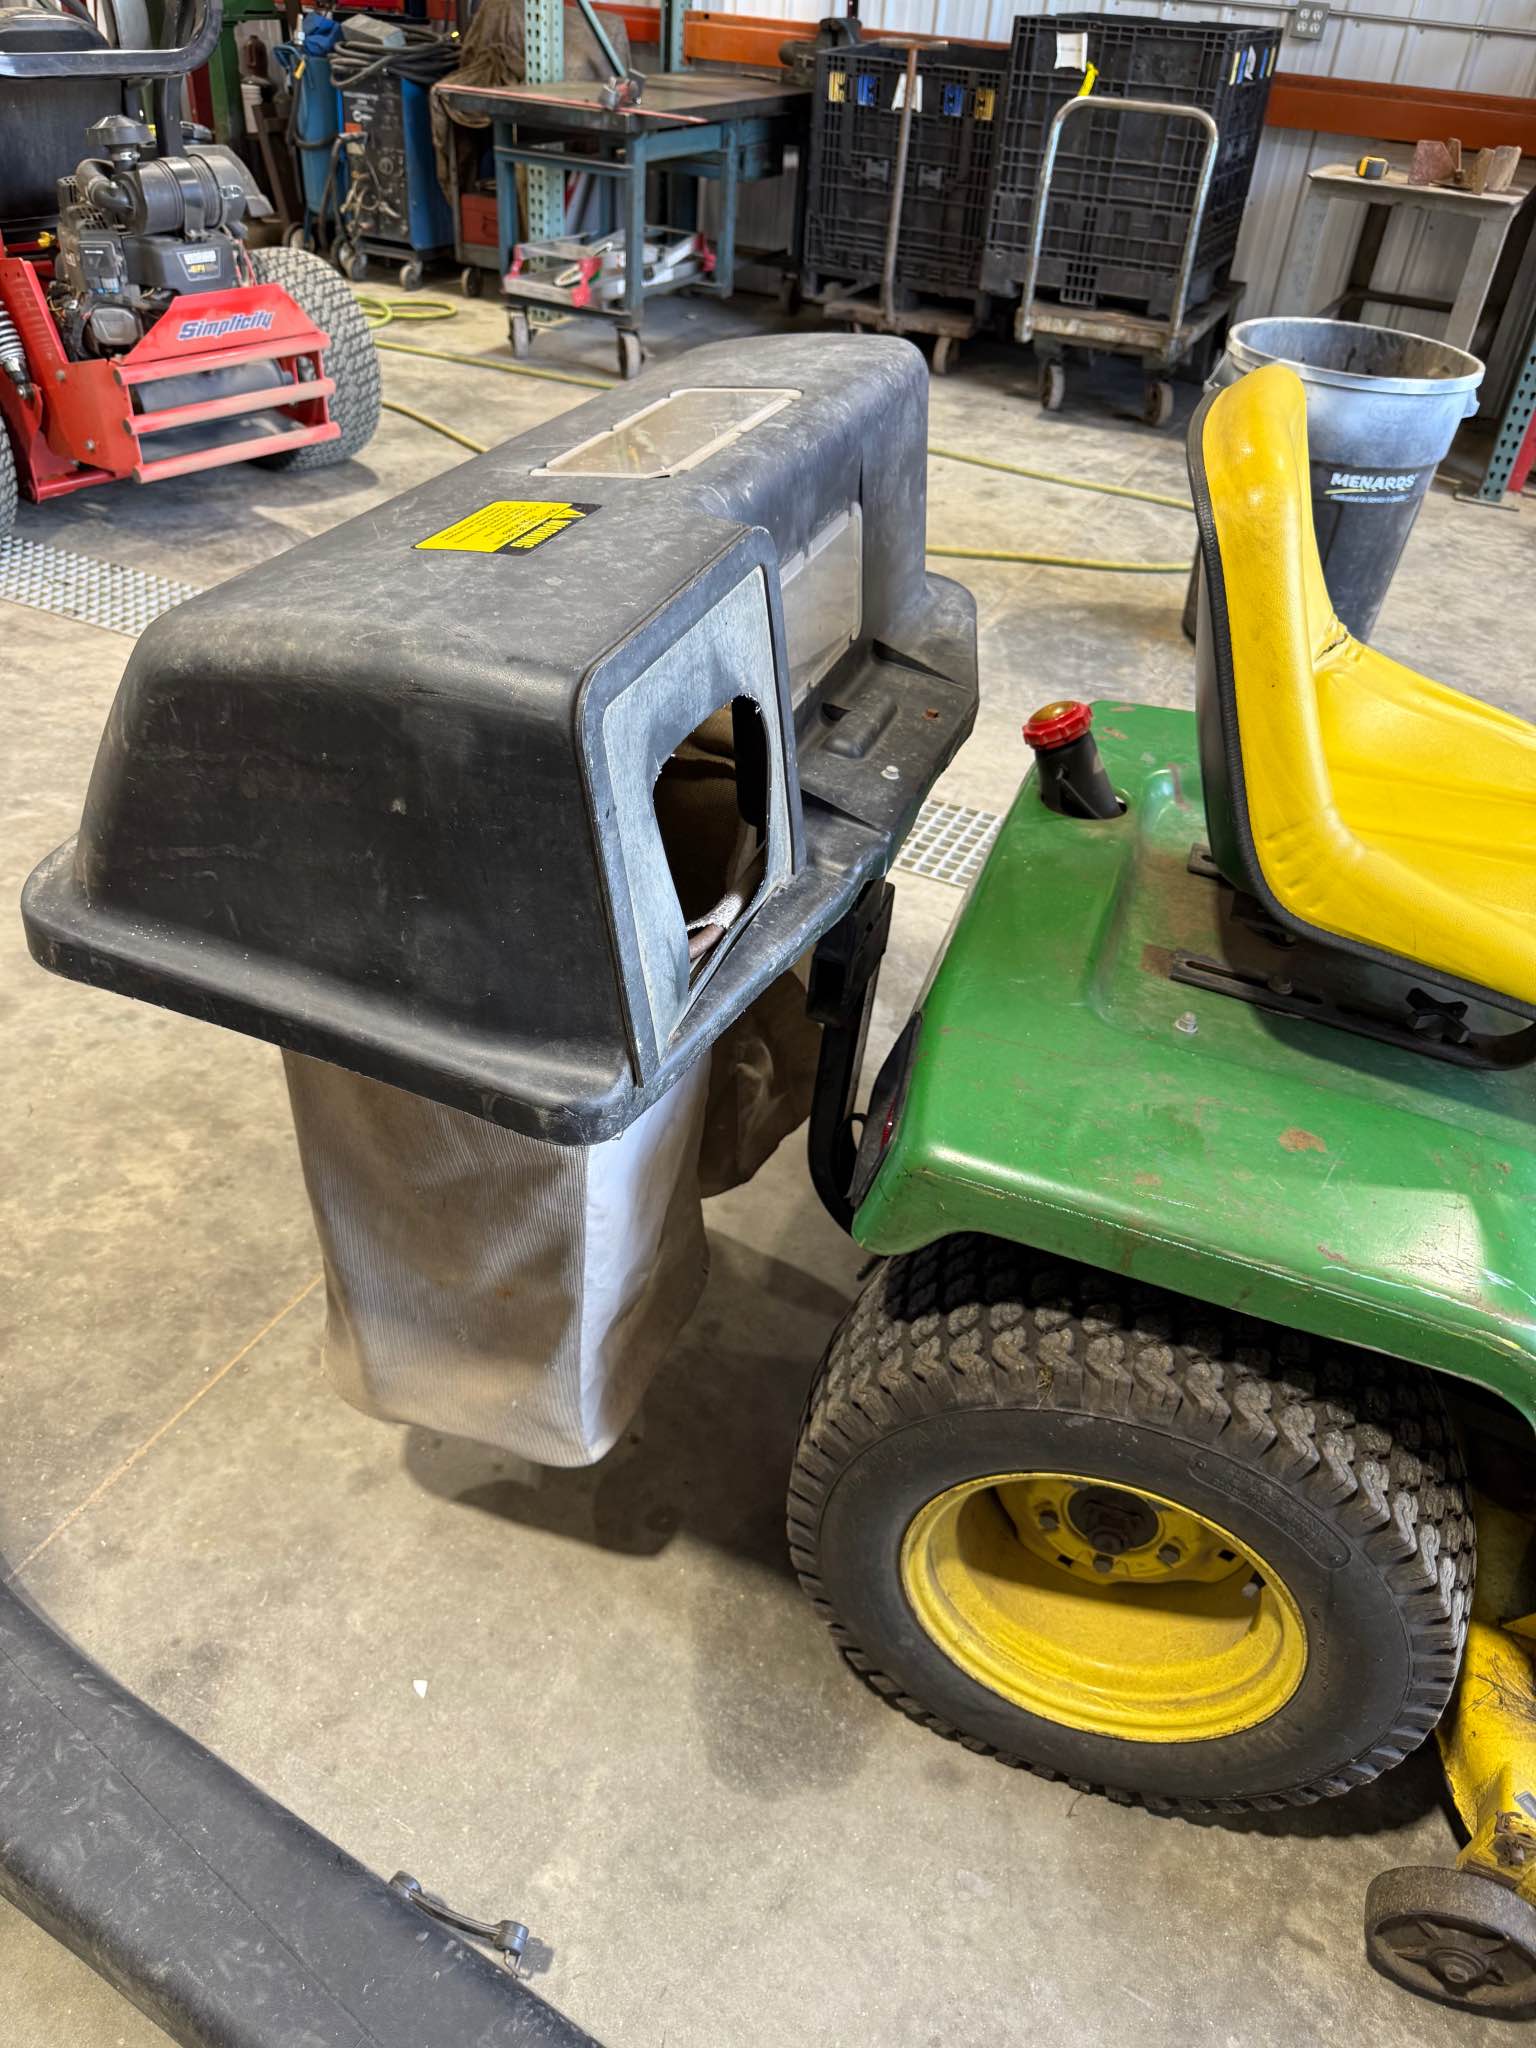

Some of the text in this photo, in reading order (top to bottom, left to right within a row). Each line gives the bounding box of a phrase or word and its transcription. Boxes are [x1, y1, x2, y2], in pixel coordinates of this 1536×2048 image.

[177, 311, 274, 341] Simplicity
[1329, 471, 1417, 491] MENARDS
[510, 519, 572, 549] WARNING
